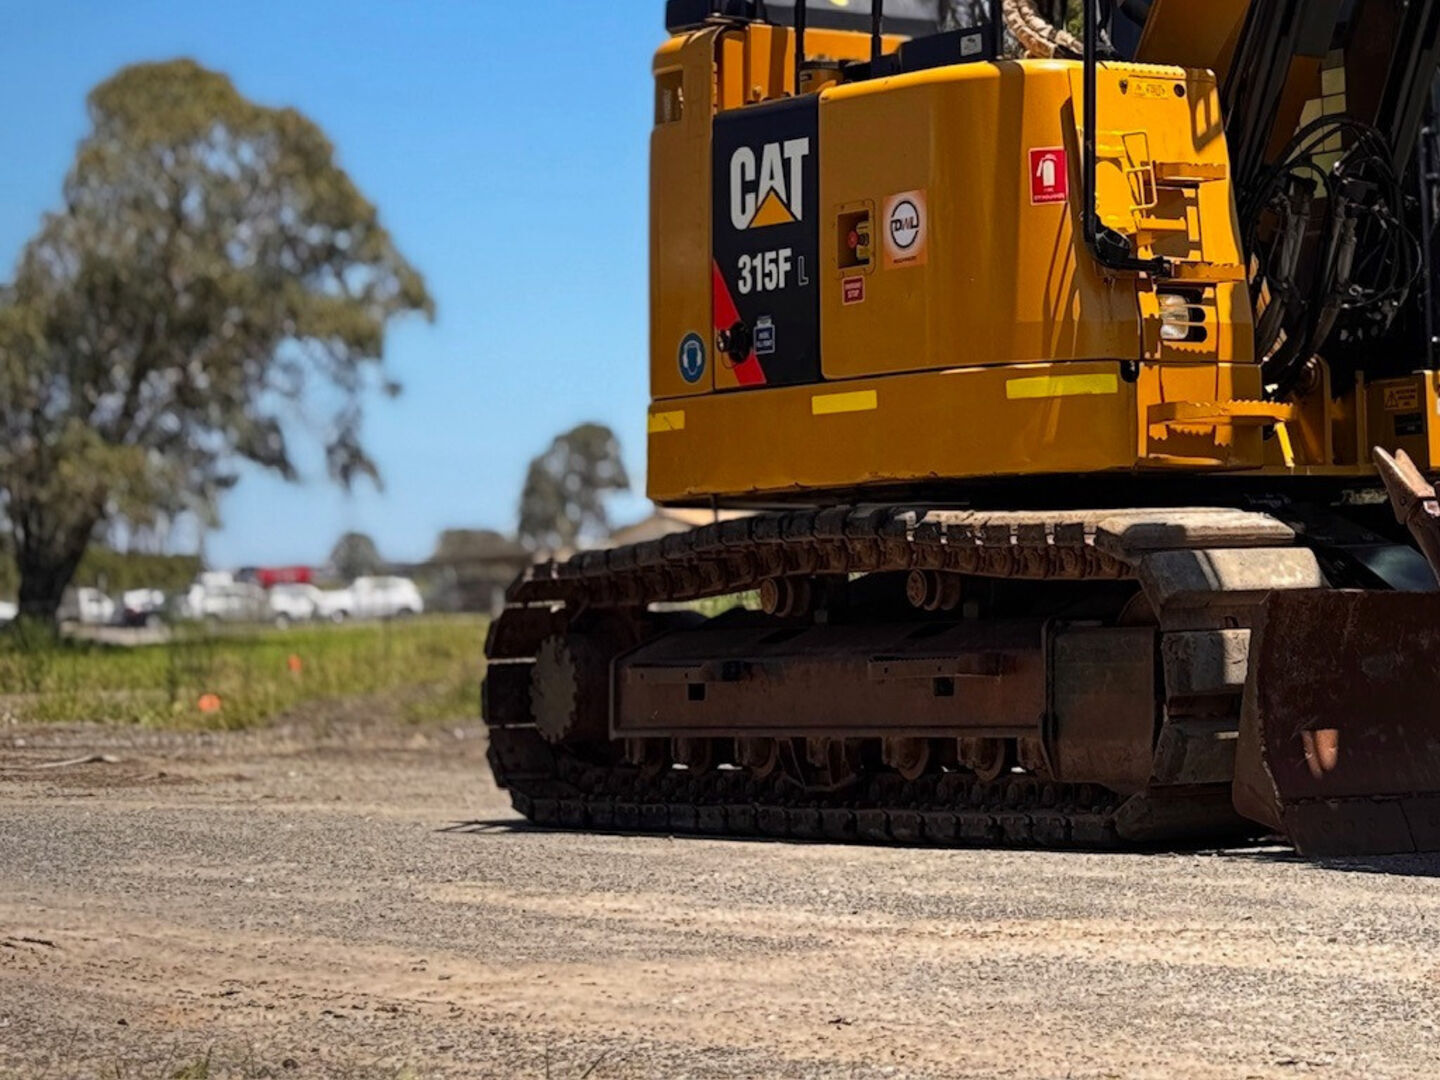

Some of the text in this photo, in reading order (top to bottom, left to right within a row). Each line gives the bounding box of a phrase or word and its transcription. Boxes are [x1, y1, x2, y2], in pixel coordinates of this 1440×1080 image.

[729, 136, 810, 231] CAT
[737, 247, 810, 295] 315F L
